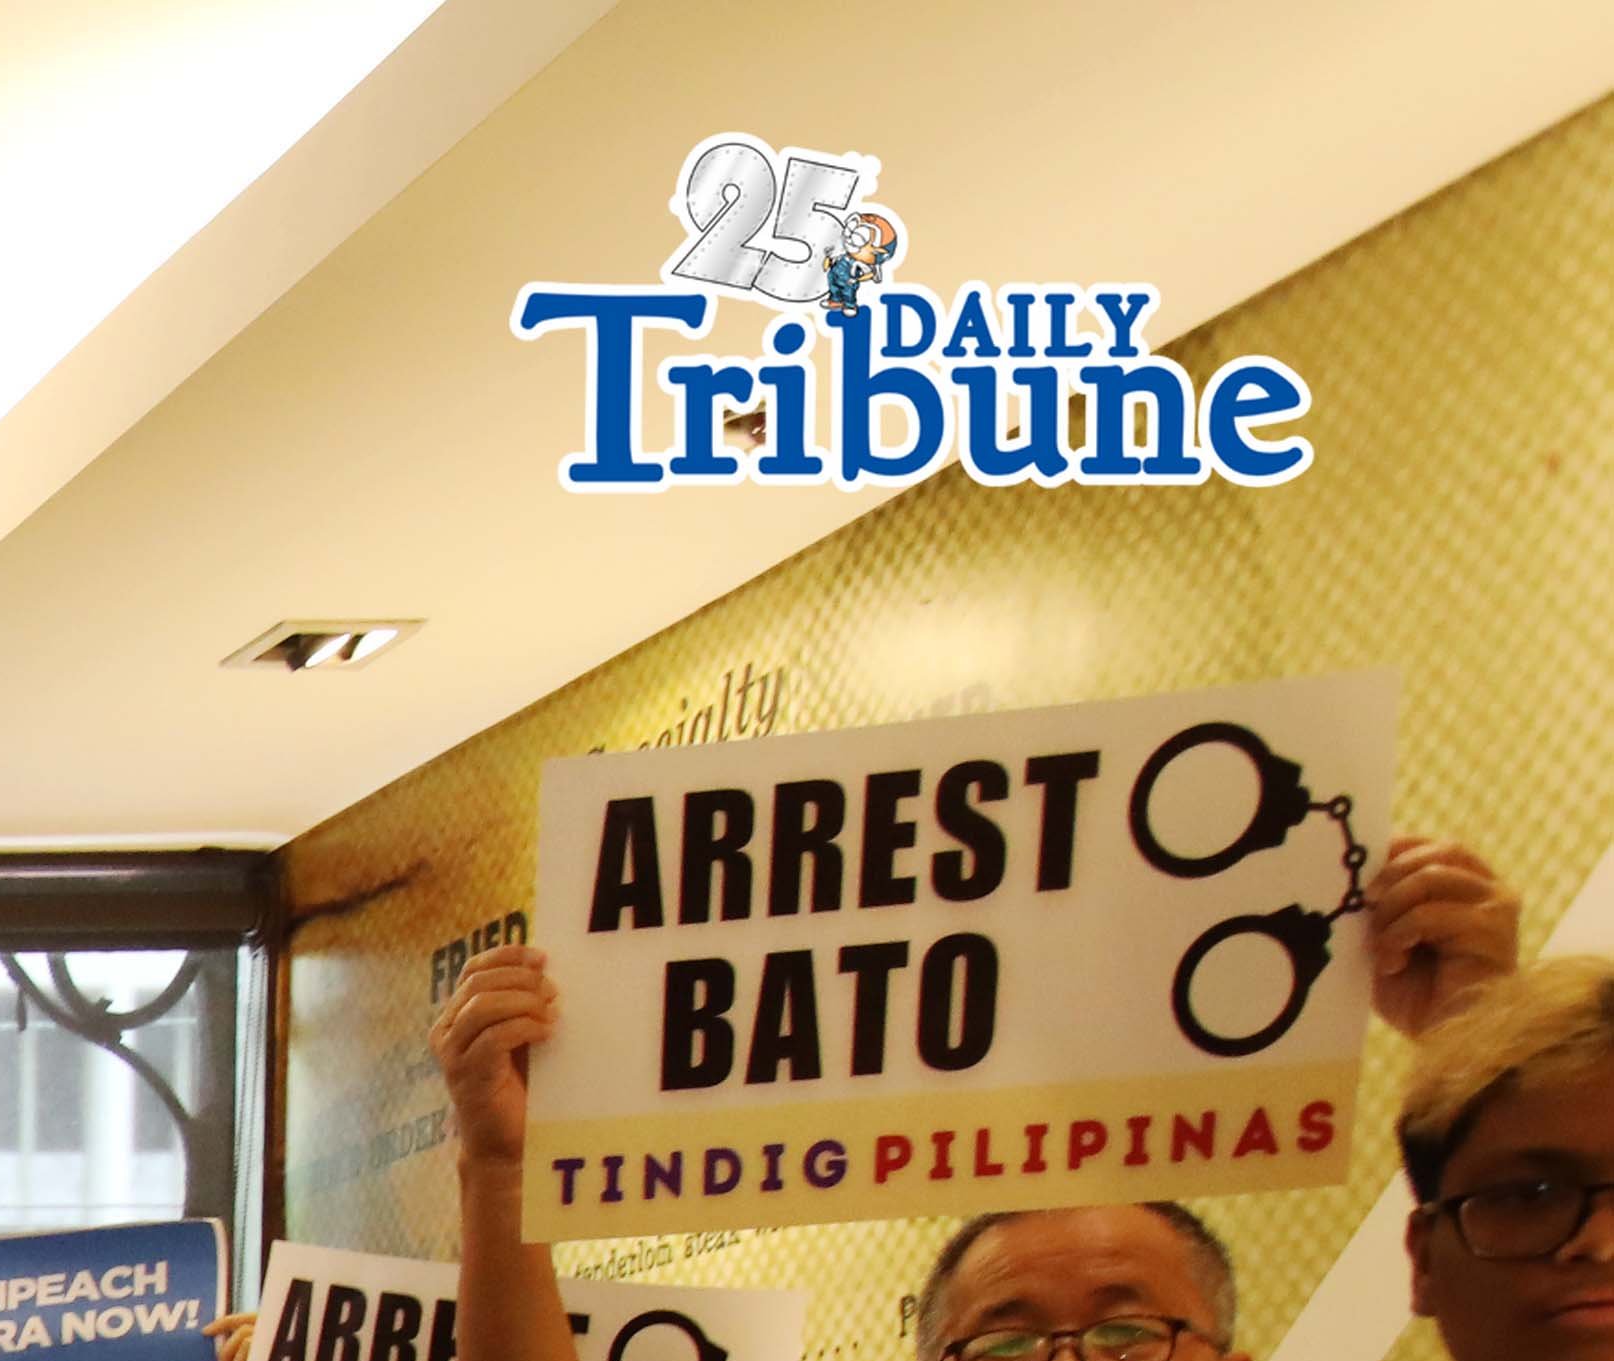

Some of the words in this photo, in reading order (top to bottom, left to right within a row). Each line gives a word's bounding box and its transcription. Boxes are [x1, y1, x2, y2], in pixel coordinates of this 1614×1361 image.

[588, 748, 1101, 934] ARREST
[660, 931, 1000, 1092] BATO
[553, 1139, 850, 1206] TINDIG
[873, 1100, 1337, 1185] PILIPINAS
[61, 1299, 201, 1342] NOW!
